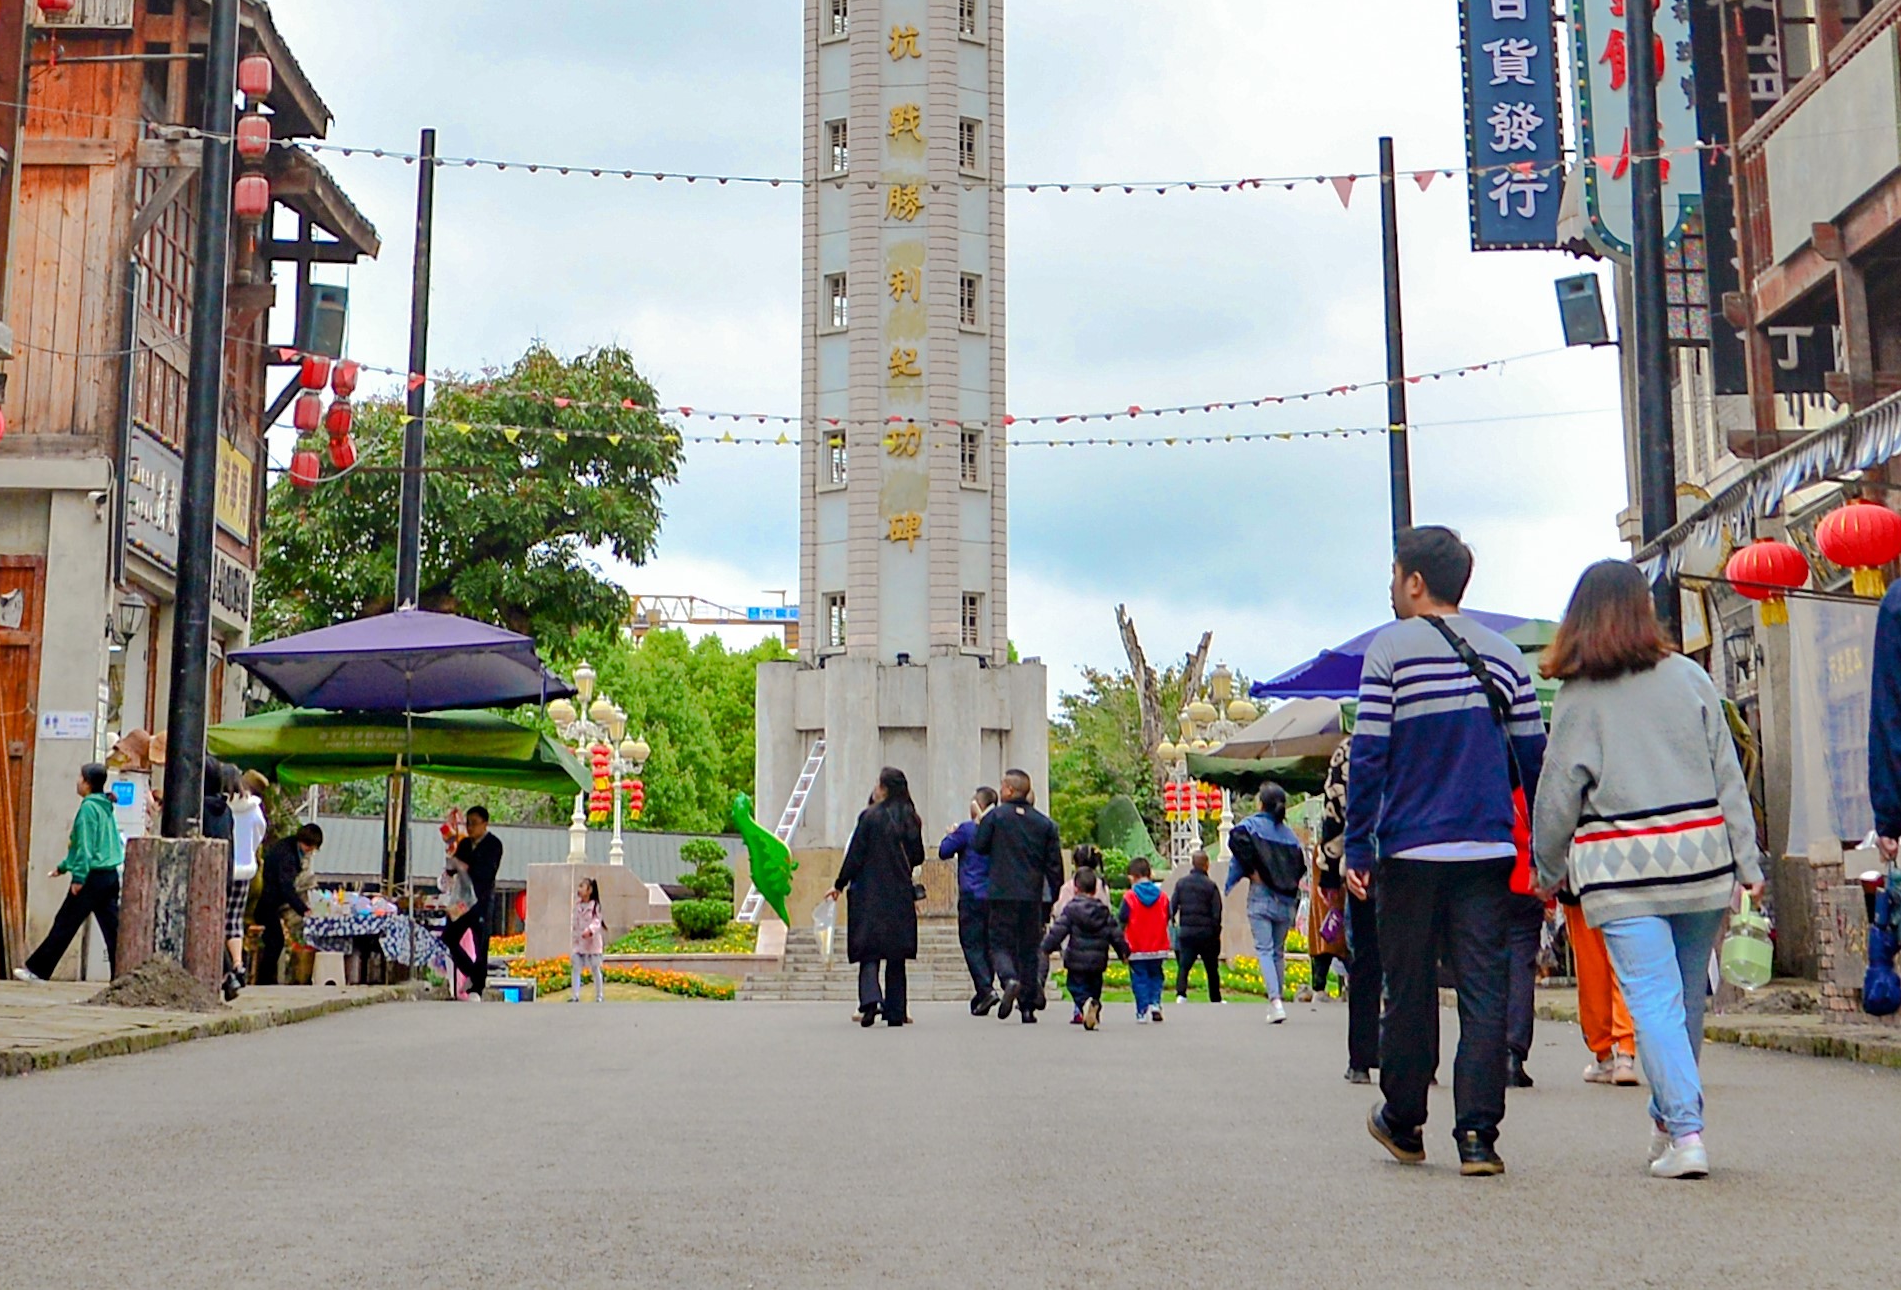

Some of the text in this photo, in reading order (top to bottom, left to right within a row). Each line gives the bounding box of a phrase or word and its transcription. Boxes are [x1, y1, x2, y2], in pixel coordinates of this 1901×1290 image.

[883, 24, 925, 552] 抗戰勝利紀功碑
